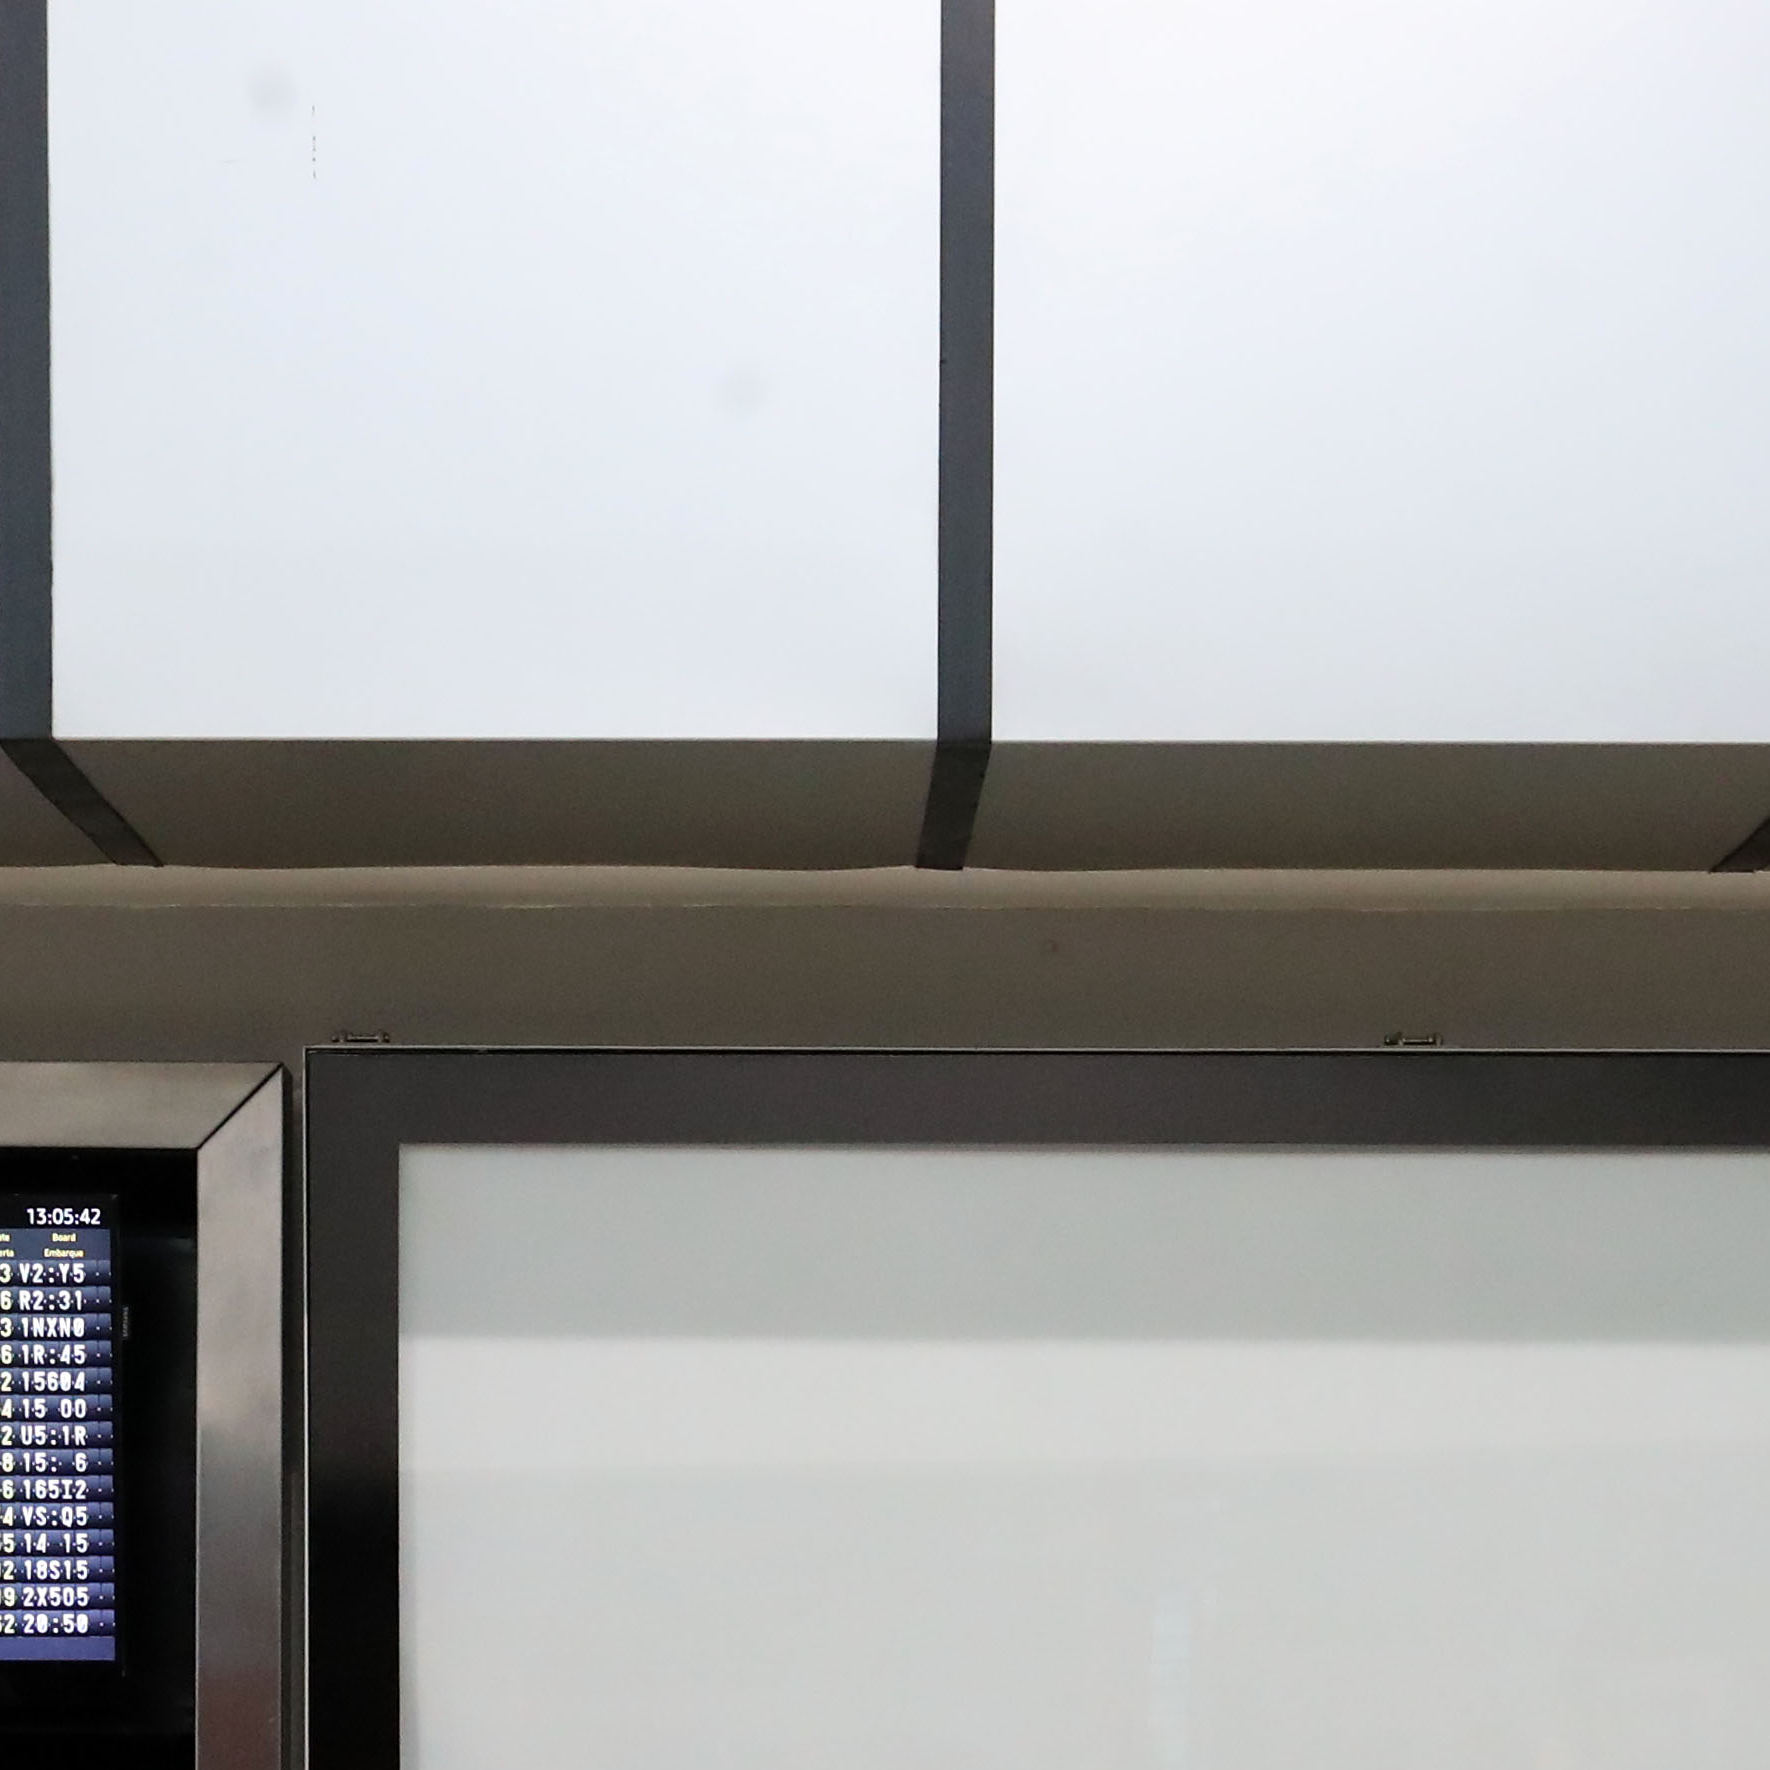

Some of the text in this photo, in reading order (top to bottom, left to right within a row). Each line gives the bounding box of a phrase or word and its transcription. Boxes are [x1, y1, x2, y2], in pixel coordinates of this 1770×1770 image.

[26, 1208, 101, 1225] 13:05:42
[52, 1233, 76, 1242] Board
[44, 1249, 84, 1259] Embarque
[19, 1290, 83, 1310] R2:31
[22, 1344, 86, 1364] 1R:45
[22, 1398, 46, 1418] 15
[23, 1533, 48, 1554] 14
[63, 1533, 88, 1554] 15
[23, 1614, 89, 1634] 20:50
